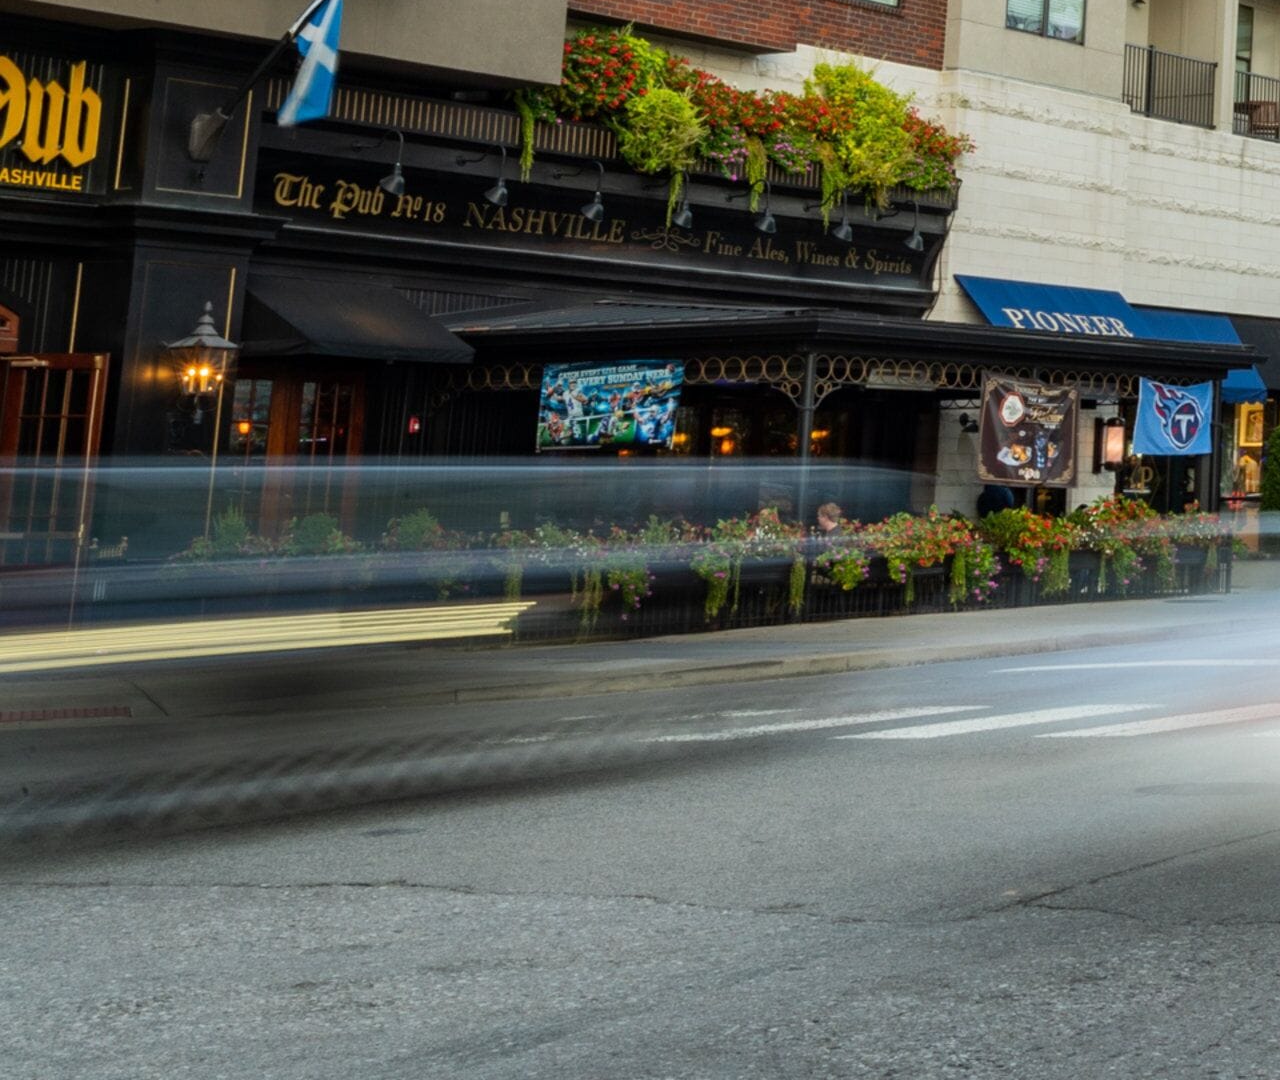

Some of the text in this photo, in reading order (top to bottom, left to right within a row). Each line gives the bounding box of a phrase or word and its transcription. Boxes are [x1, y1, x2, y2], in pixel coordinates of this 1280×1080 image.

[0, 167, 83, 190] ASHVILLE
[273, 172, 325, 209] The
[330, 179, 385, 220] Pub
[463, 202, 627, 244] NASHVILLE
[703, 230, 913, 275] Fine Ales, Wines & Spirits
[1001, 307, 1134, 338] PIONEER
[607, 371, 644, 383] SUNDAY
